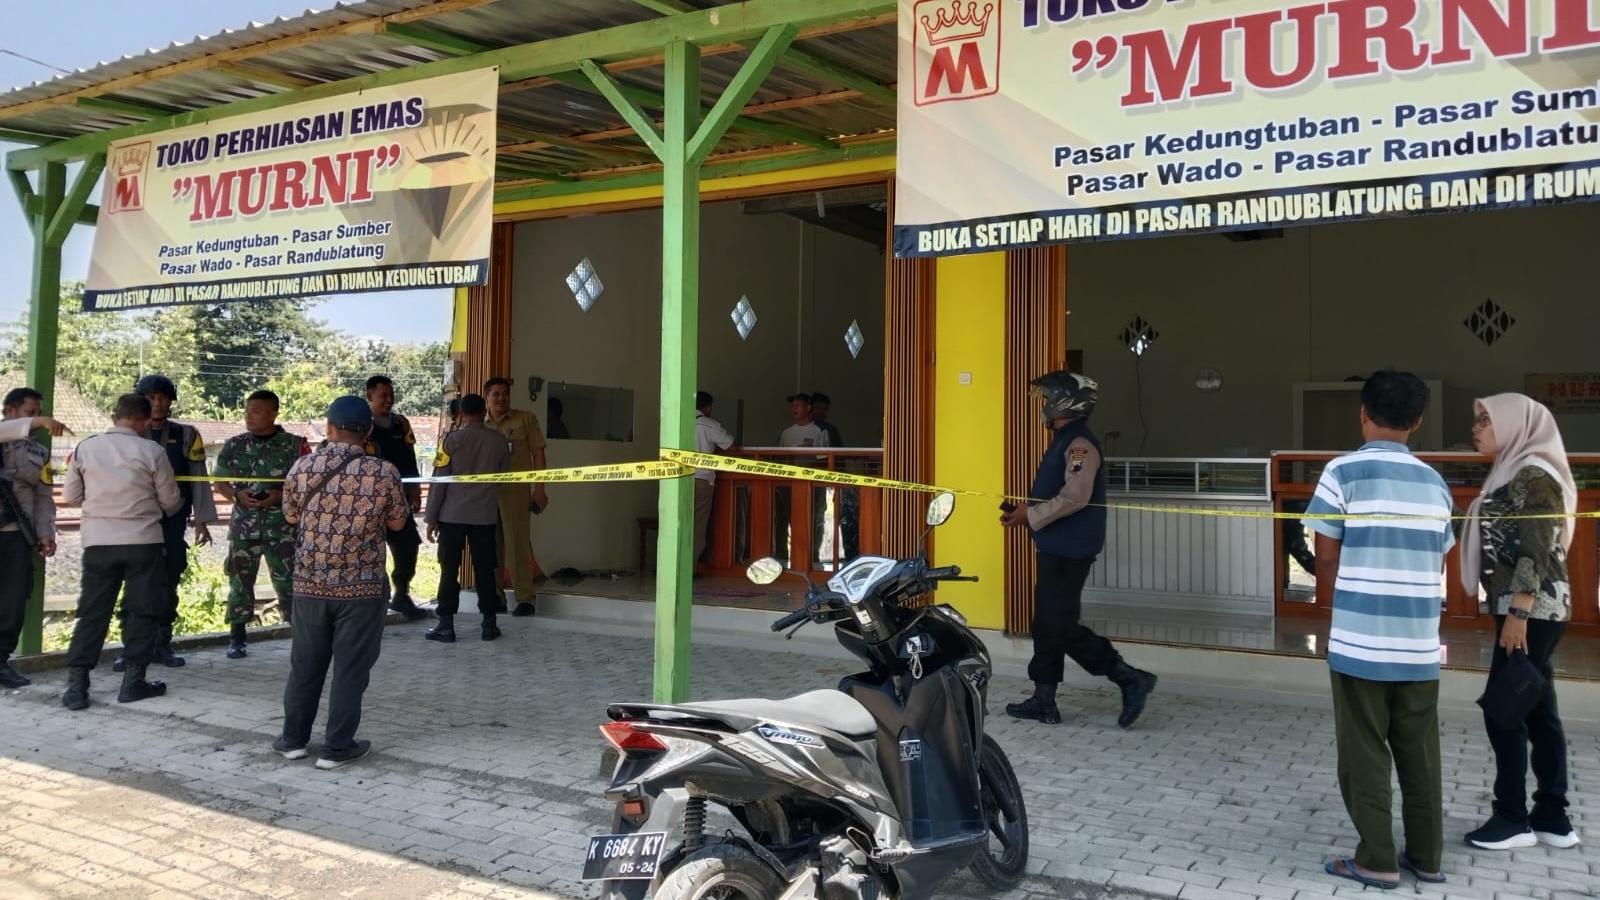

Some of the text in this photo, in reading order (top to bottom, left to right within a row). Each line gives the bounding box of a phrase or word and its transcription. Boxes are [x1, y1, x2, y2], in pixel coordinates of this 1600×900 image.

[924, 42, 988, 97] M
[157, 97, 423, 168] TOKO PERHIASAN EMAS
[1055, 142, 1135, 167] Pasar
[1145, 116, 1359, 156] Kedungtuban
[1395, 100, 1498, 128] Pasar
[1068, 172, 1148, 196] Pasar
[1158, 158, 1242, 186] Wado
[1275, 147, 1371, 173] Pasar
[918, 226, 971, 251] BUKA
[976, 218, 1043, 248] SETIAP
[1048, 213, 1101, 240] HARI
[1106, 210, 1130, 235] DI
[1136, 203, 1212, 233] PASAR
[1217, 183, 1423, 226] RANDUBLATUNG
[1431, 176, 1487, 209] DAN
[1496, 174, 1525, 203] DI
[159, 244, 193, 258] Pasar
[196, 233, 279, 255] Kedungtuban
[292, 227, 332, 244] Pasar
[336, 220, 391, 239] Sumber
[160, 262, 197, 275] Pasar
[200, 257, 232, 273] Wado
[244, 253, 282, 268] Pasar
[287, 243, 384, 265] Randublatung
[95, 265, 480, 309] BUKA SETIAP HARI DI PASAR RANDUBLATUNG DAN DI RUMAH KEDUNGTUBAN
[588, 836, 662, 860] K 6684 KY
